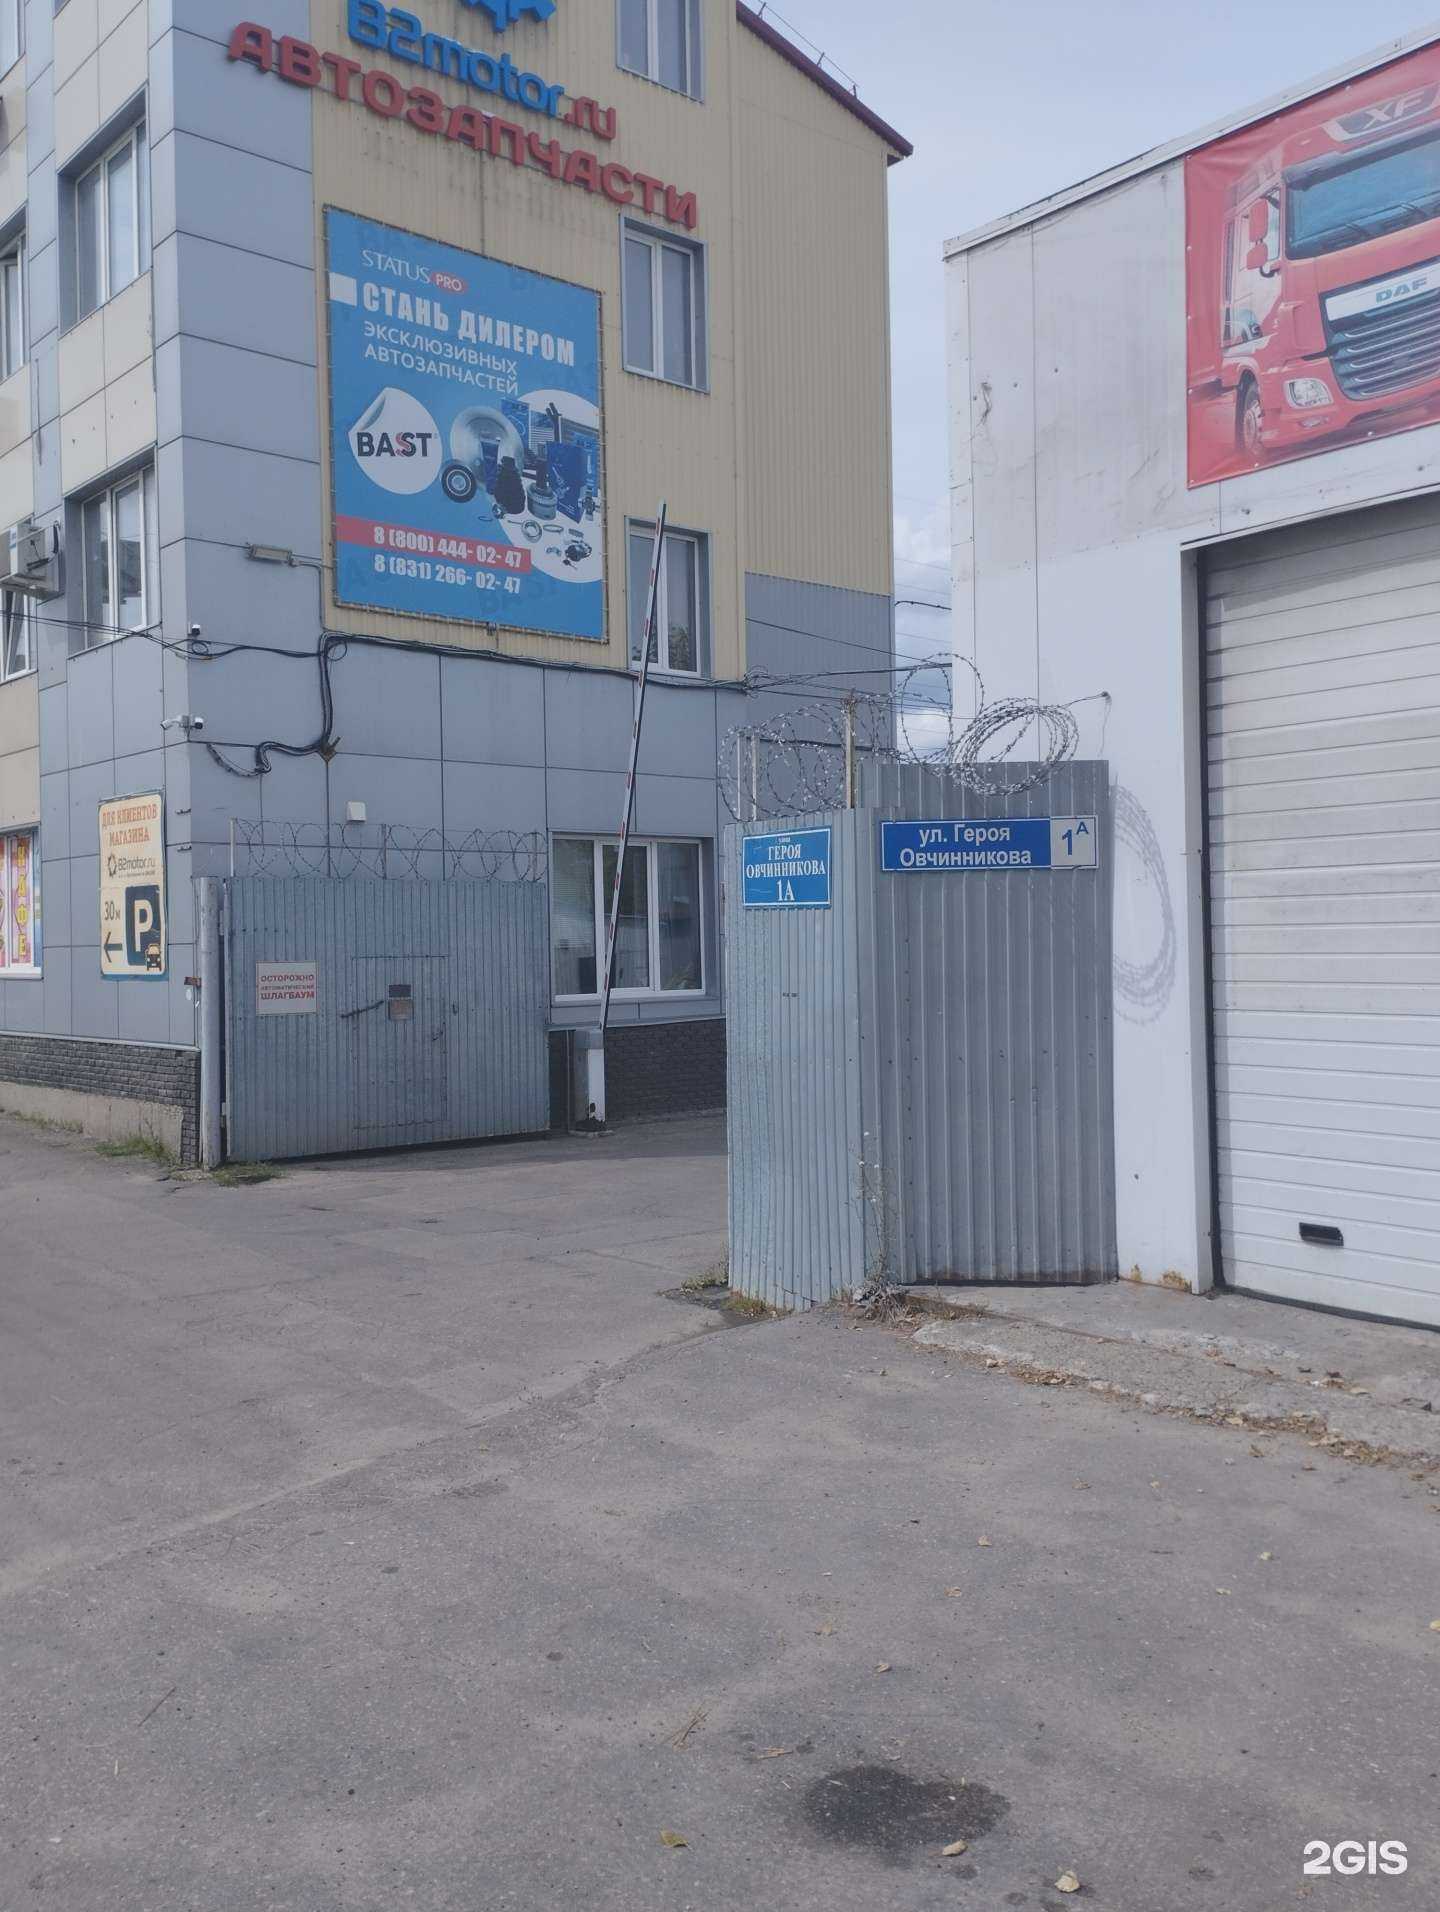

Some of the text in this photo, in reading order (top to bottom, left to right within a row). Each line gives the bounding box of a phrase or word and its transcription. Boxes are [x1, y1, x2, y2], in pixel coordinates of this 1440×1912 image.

[1362, 91, 1425, 130] XF
[228, 22, 697, 230] АВТОЗАПЧАСТИ
[362, 250, 463, 292] STATUS PRO
[1375, 277, 1427, 304] DAF
[363, 282, 575, 367] СТАНЬ ДИЛЕРОМ
[364, 320, 518, 377] ЭКСКЛЮЗИВНЫХ
[364, 344, 519, 397] АВТОЗАПЧАСТЕЙ
[357, 432, 432, 457] BAST
[374, 526, 385, 545] 8
[389, 528, 434, 553] (800)
[374, 554, 386, 573] 8
[389, 556, 431, 580] (831)
[109, 826, 150, 847] МАГАЗИНА
[919, 823, 1011, 847] ул. Героя
[768, 844, 801, 860] ГЕРОЯ
[900, 848, 1032, 867] Овчинникова
[746, 860, 826, 878] ОВЧИННИКОВА
[776, 880, 795, 902] 1А
[260, 974, 315, 982] ОСТОРОЖНО
[260, 991, 315, 1000] ШЛАГБАУМ
